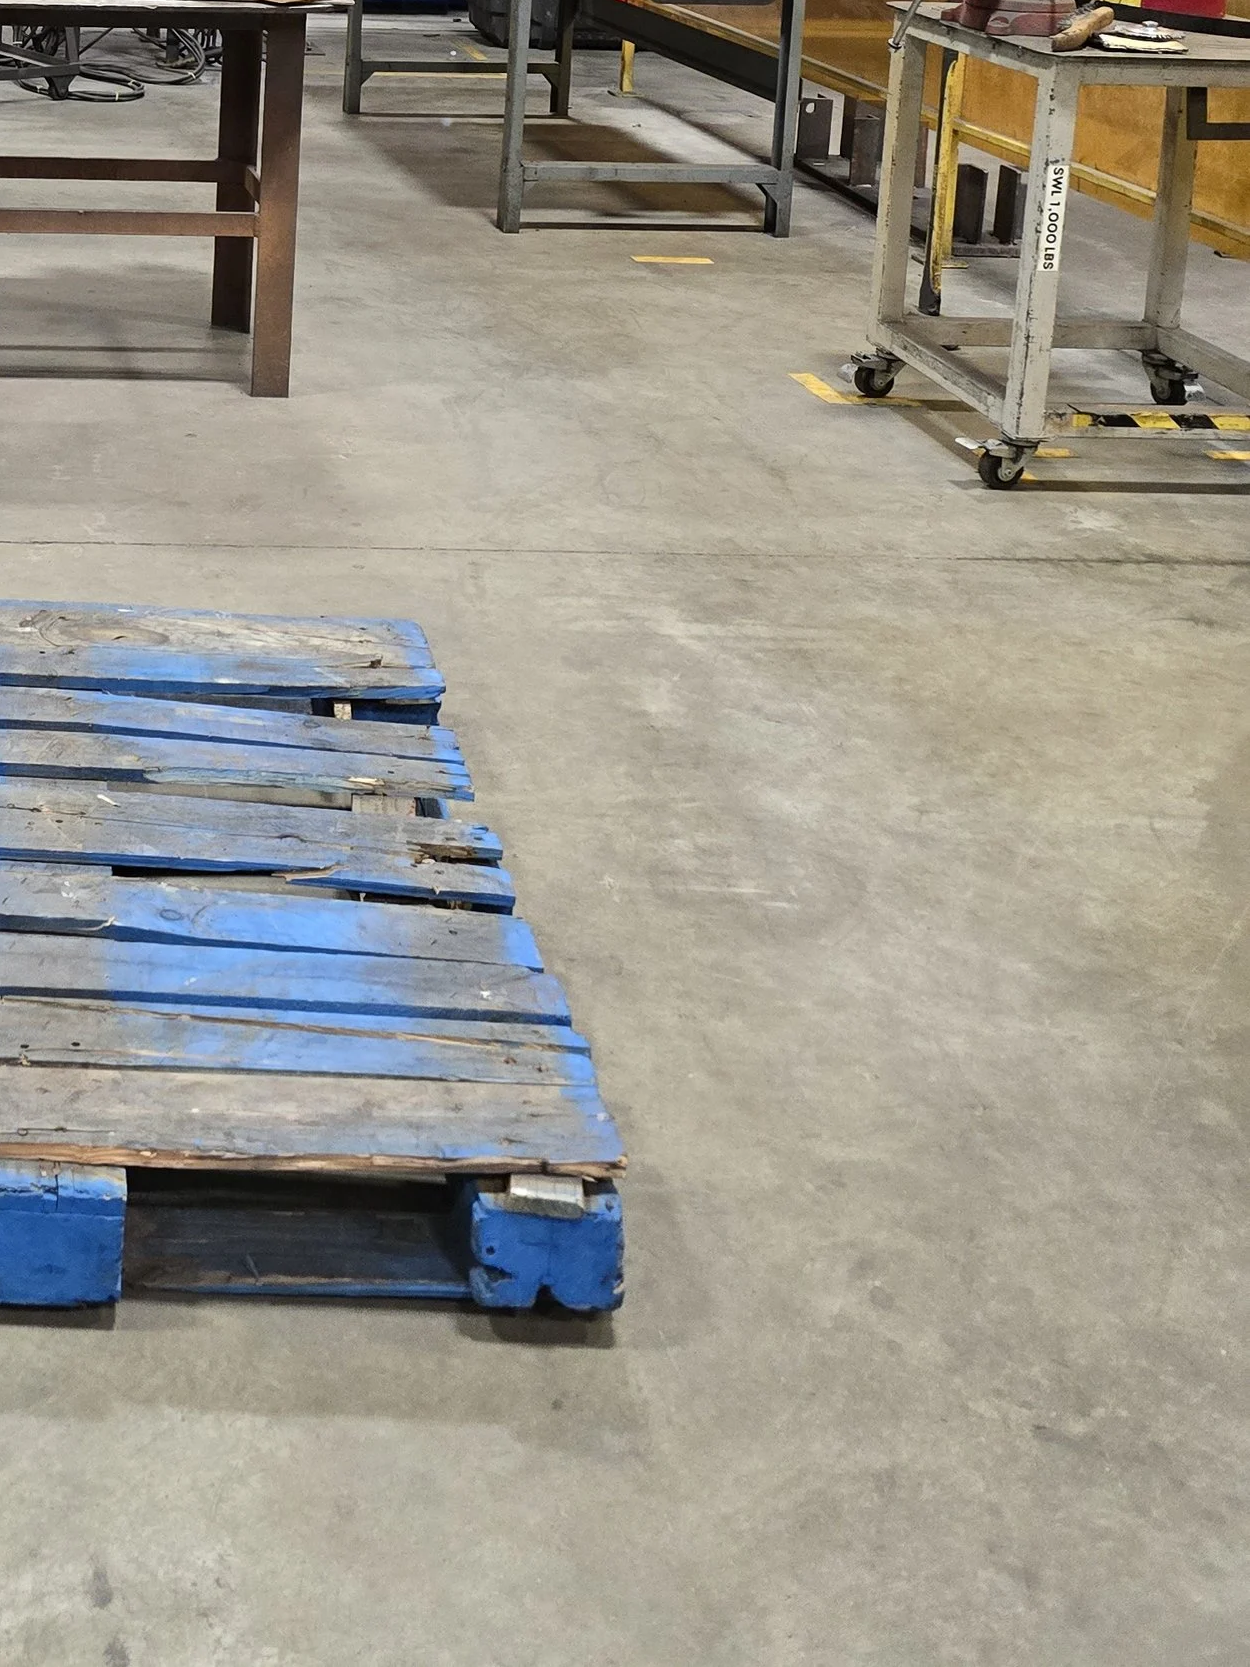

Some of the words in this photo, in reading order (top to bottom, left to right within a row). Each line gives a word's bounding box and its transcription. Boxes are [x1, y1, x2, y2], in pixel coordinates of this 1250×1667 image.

[1051, 167, 1065, 196] SWL
[1046, 201, 1061, 244] 1,000
[1043, 247, 1056, 270] LBS
